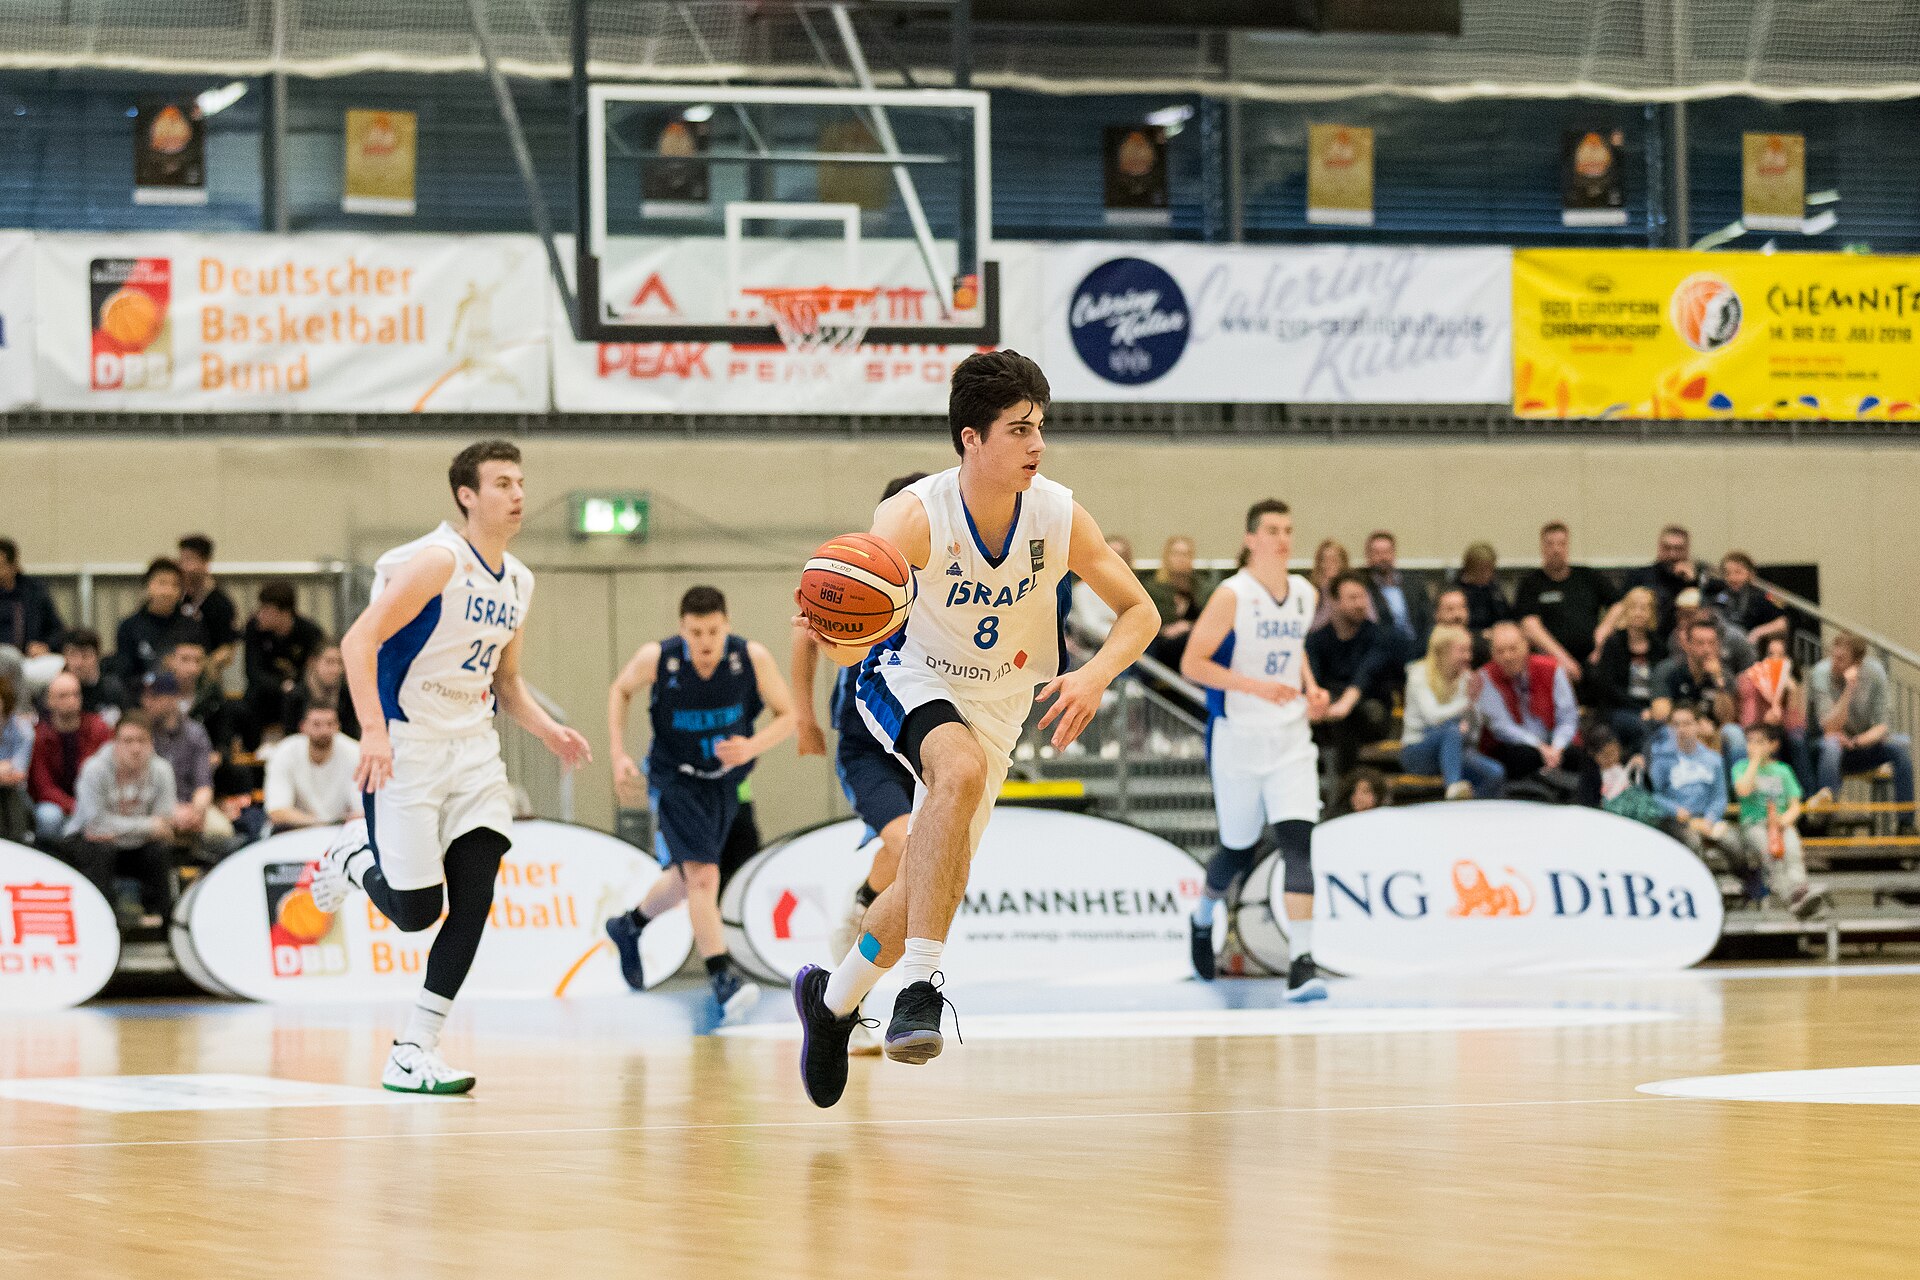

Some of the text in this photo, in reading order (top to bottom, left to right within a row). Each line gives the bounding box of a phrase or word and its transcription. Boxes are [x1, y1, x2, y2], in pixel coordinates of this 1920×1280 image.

[200, 258, 415, 297] Deutscher
[201, 306, 426, 344] Basketball
[201, 354, 310, 392] Bund
[597, 343, 711, 379] PEAK
[865, 361, 957, 383] SPO
[820, 587, 844, 604] FIBA
[945, 573, 1038, 608] ISRAEL
[465, 594, 519, 631] ISRAE
[806, 607, 864, 633] molten
[973, 615, 1000, 650] 8
[461, 639, 497, 675] 24
[925, 655, 991, 681] הפועלים
[1264, 651, 1292, 675] 87
[1324, 870, 1699, 920] NG DiBa
[0, 883, 77, 945] 育
